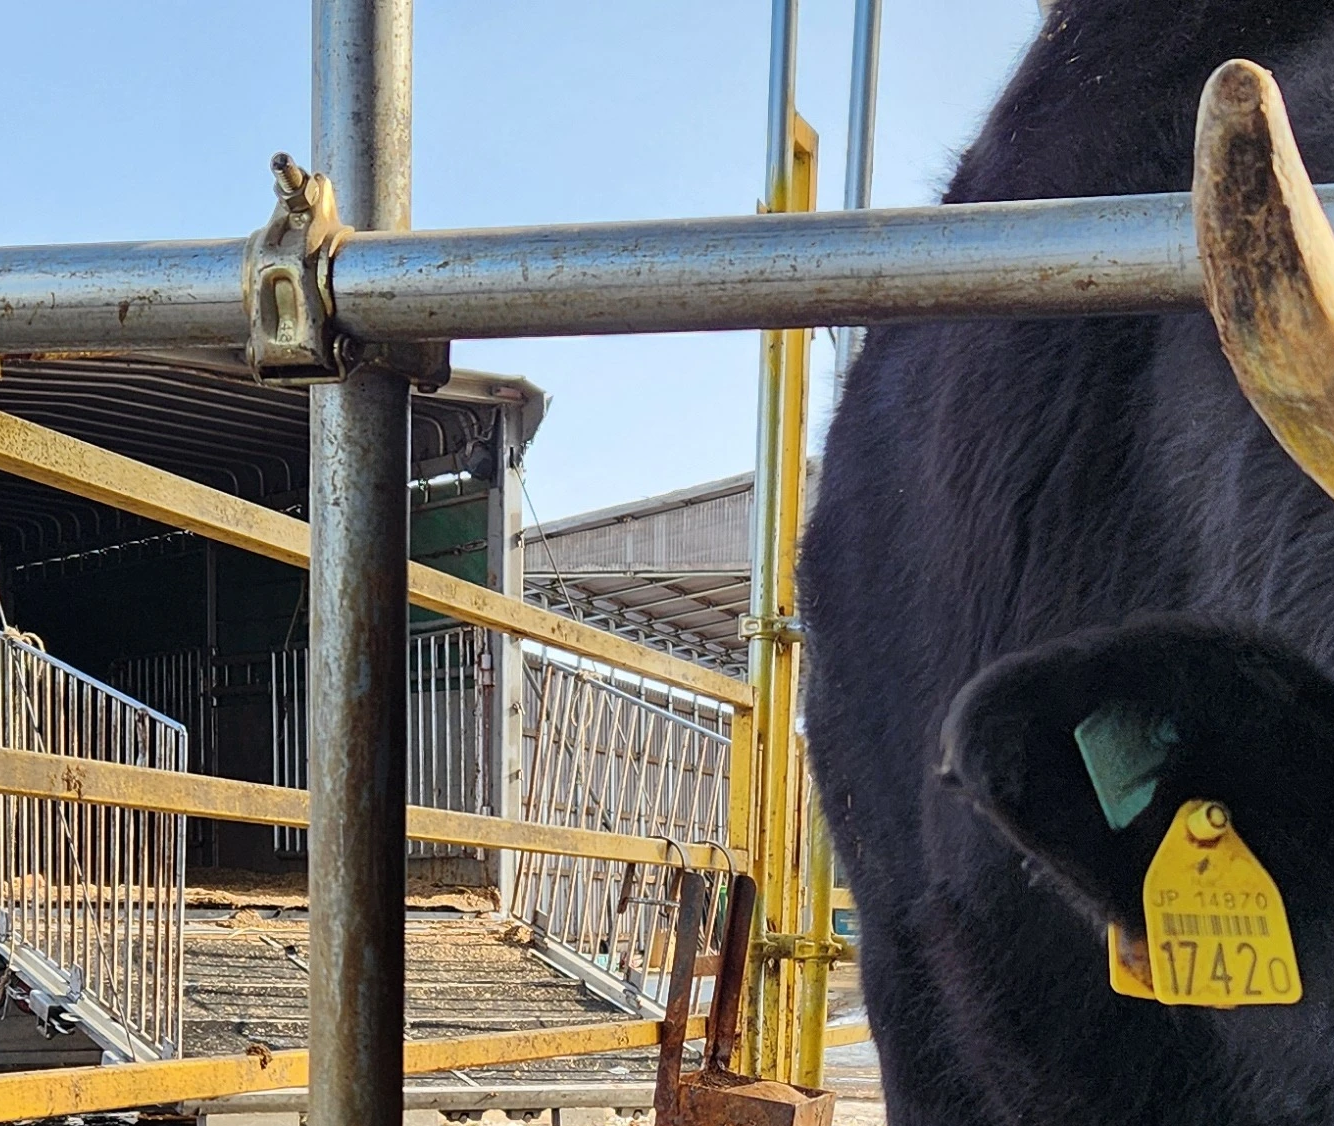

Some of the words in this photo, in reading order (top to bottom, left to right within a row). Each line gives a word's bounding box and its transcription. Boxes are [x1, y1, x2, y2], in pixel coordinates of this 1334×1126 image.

[1152, 889, 1179, 908] JP
[1195, 890, 1268, 909] 14870
[1160, 940, 1292, 996] 17420
